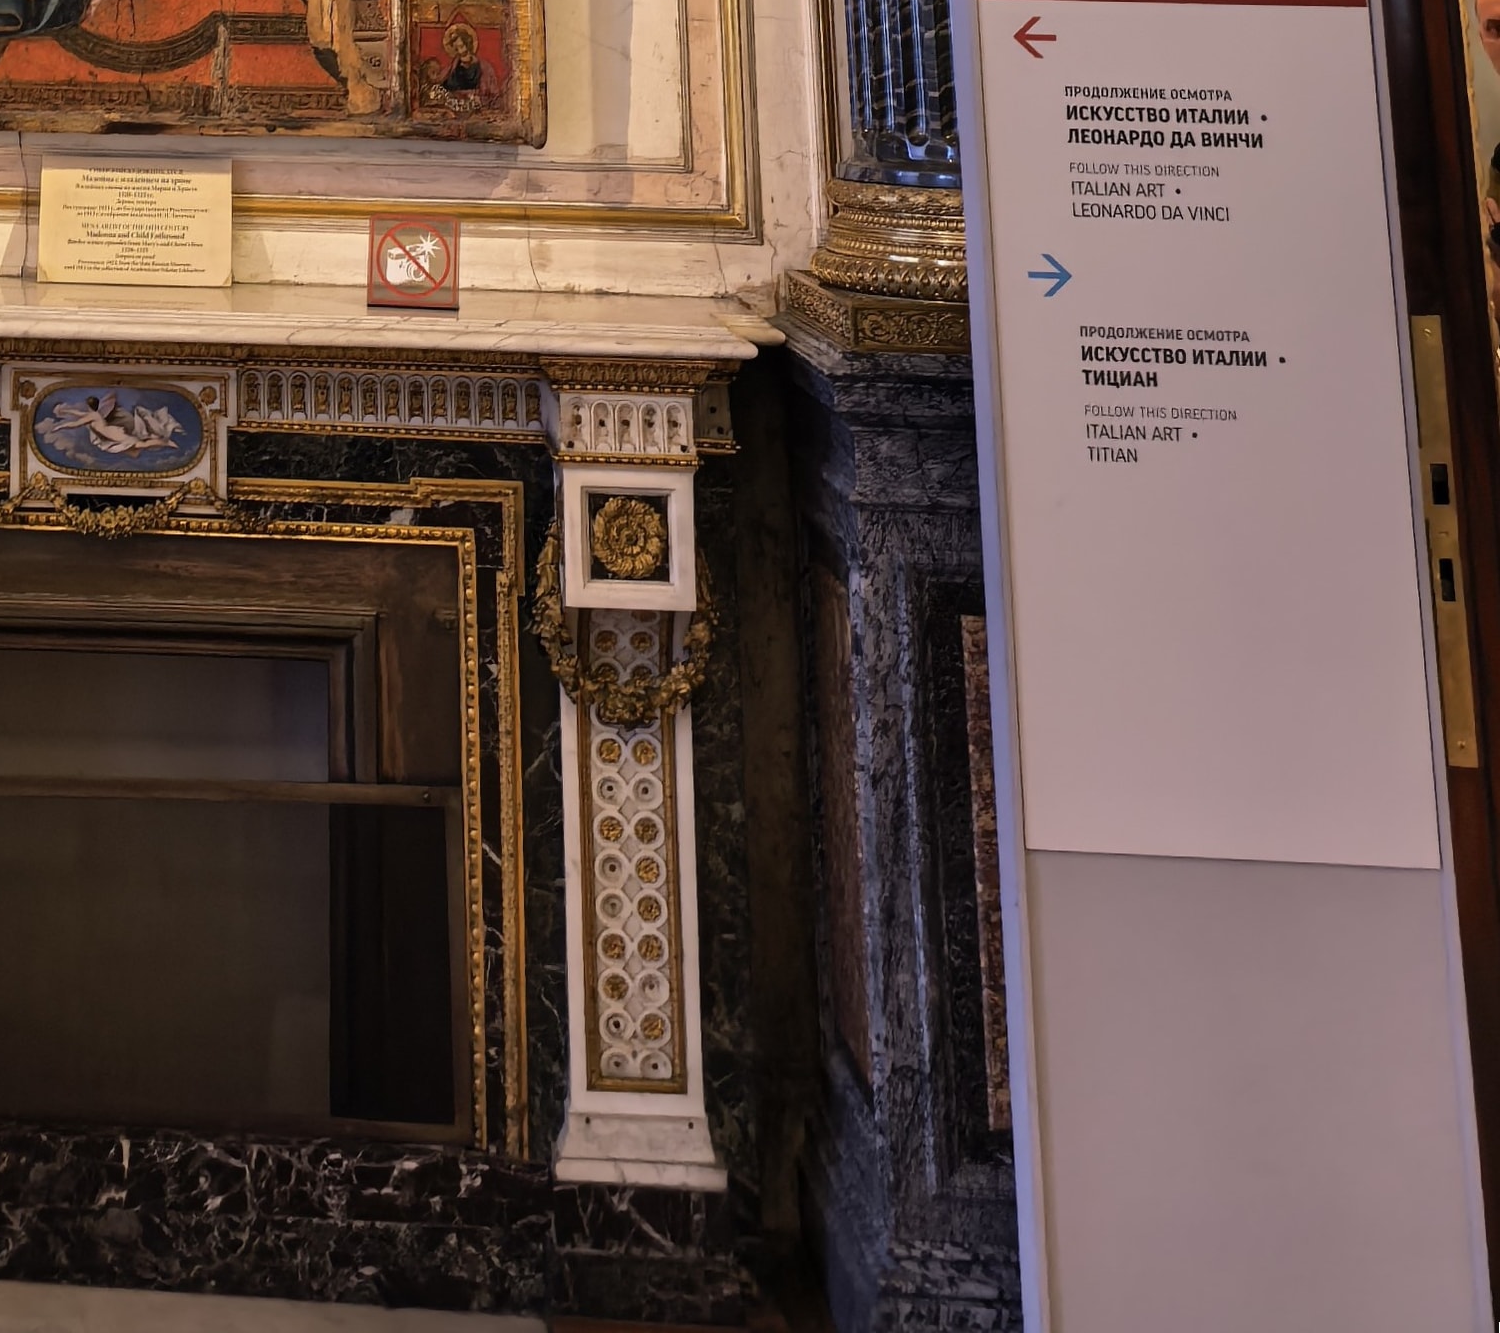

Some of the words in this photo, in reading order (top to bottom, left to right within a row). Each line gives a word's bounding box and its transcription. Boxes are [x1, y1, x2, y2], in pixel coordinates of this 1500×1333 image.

[1065, 86, 1166, 99] ПРОДОЛЖЕНИЕ
[1171, 89, 1232, 101] ОСМОТРА
[1067, 105, 1170, 122] ИСКУССТВО
[1176, 108, 1249, 125] ИТАЛИИ
[1068, 129, 1164, 147] ЛЕОНАРДО
[1170, 131, 1196, 148] ДА
[1201, 132, 1263, 148] ВИНЧИ
[1070, 162, 1119, 174] FOLLOW
[1124, 164, 1151, 175] THIS
[1155, 165, 1219, 177] DIRECTION
[1072, 181, 1130, 196] ITALIAN
[1136, 183, 1165, 197] ART
[1073, 203, 1156, 220] LEONARDO
[1162, 206, 1183, 220] DA
[1187, 207, 1229, 221] VINCI
[1080, 326, 1183, 340] ПРОДОЛЖЕНИЕ
[1187, 330, 1250, 342] ОСМОТРА
[1081, 346, 1186, 364] ИСКУССТВО
[1193, 349, 1267, 367] ИТАЛИИ
[1082, 370, 1158, 388] ТИЦИАН
[1085, 405, 1134, 417] FOLLOW
[1140, 407, 1166, 418] THIS
[1171, 408, 1237, 421] DIRECTION
[1087, 424, 1146, 440] ITALIAN
[1152, 427, 1182, 441] ART
[1087, 446, 1137, 462] TITIAN
